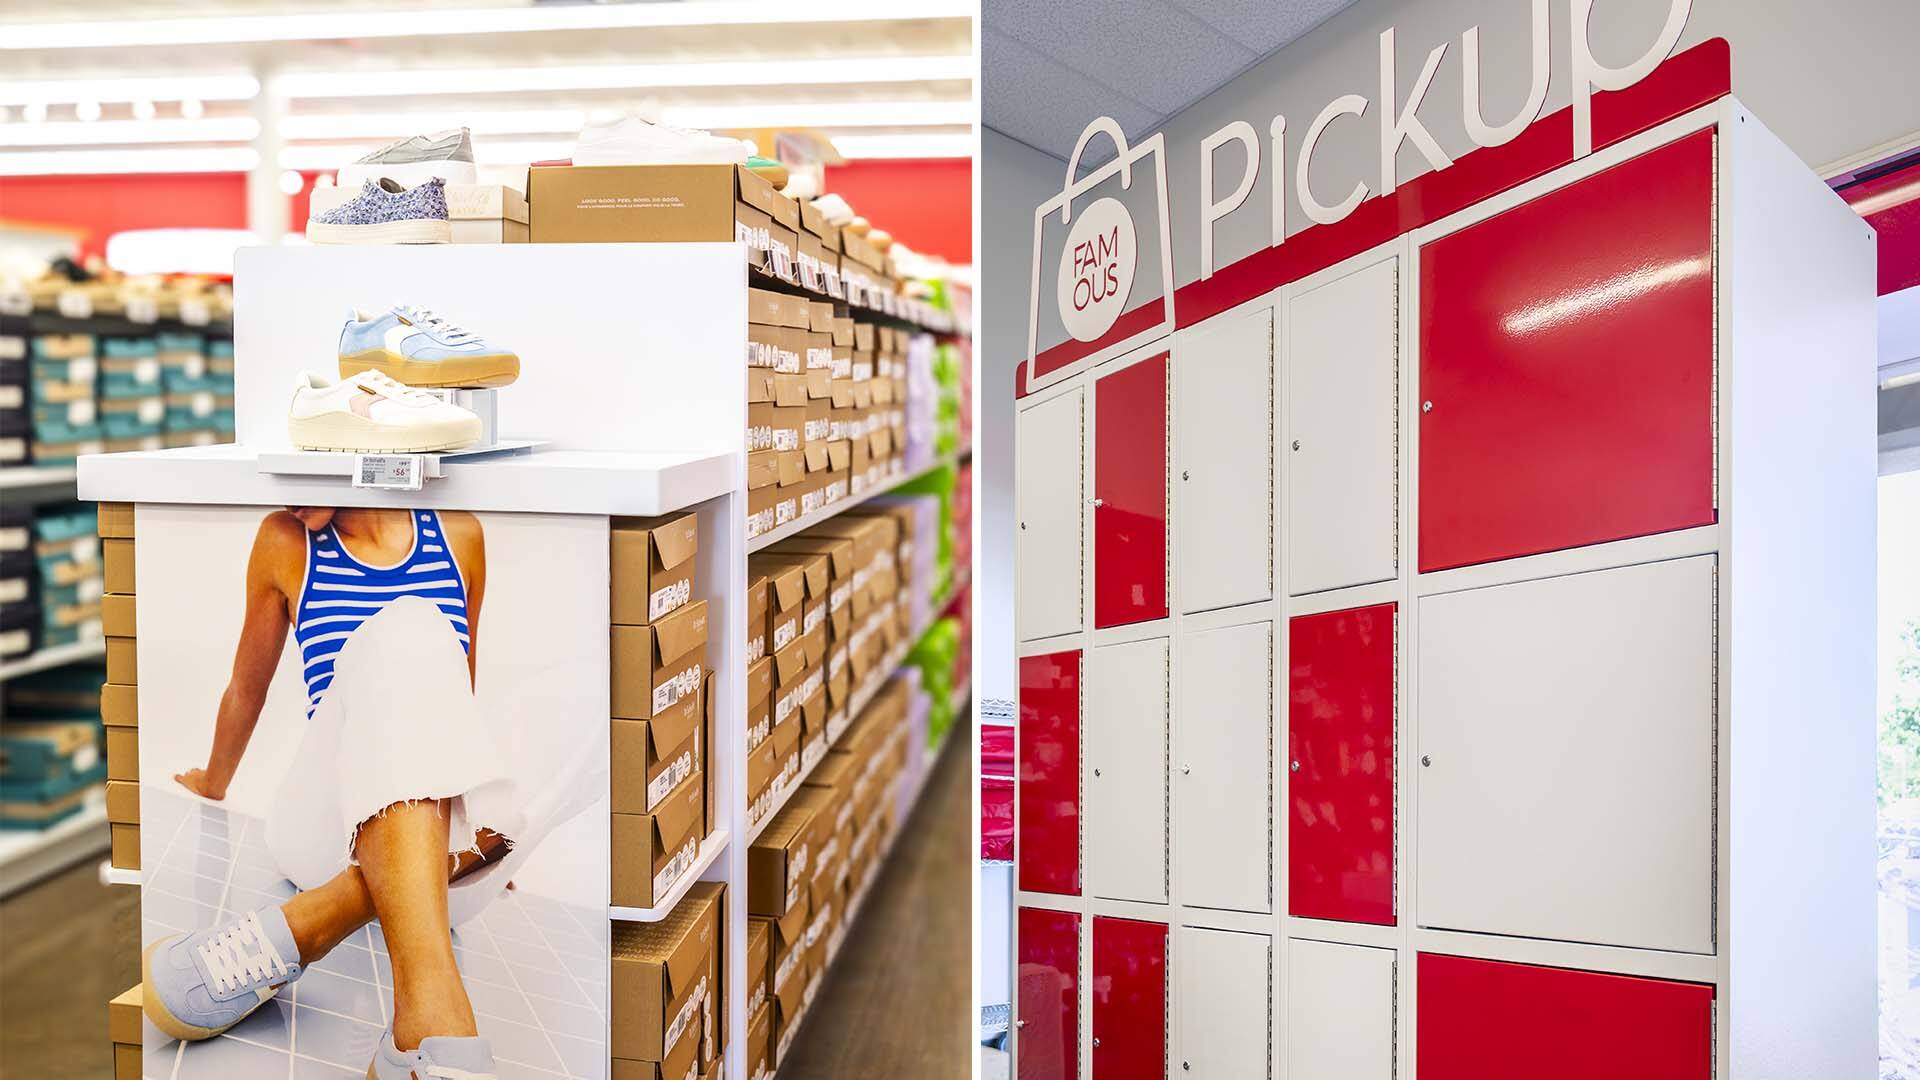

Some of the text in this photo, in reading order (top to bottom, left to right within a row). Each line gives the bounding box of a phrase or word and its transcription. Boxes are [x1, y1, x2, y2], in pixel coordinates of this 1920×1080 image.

[1200, 0, 1695, 281] Pickup
[1074, 225, 1118, 278] FAM
[1073, 263, 1119, 312] OUS
